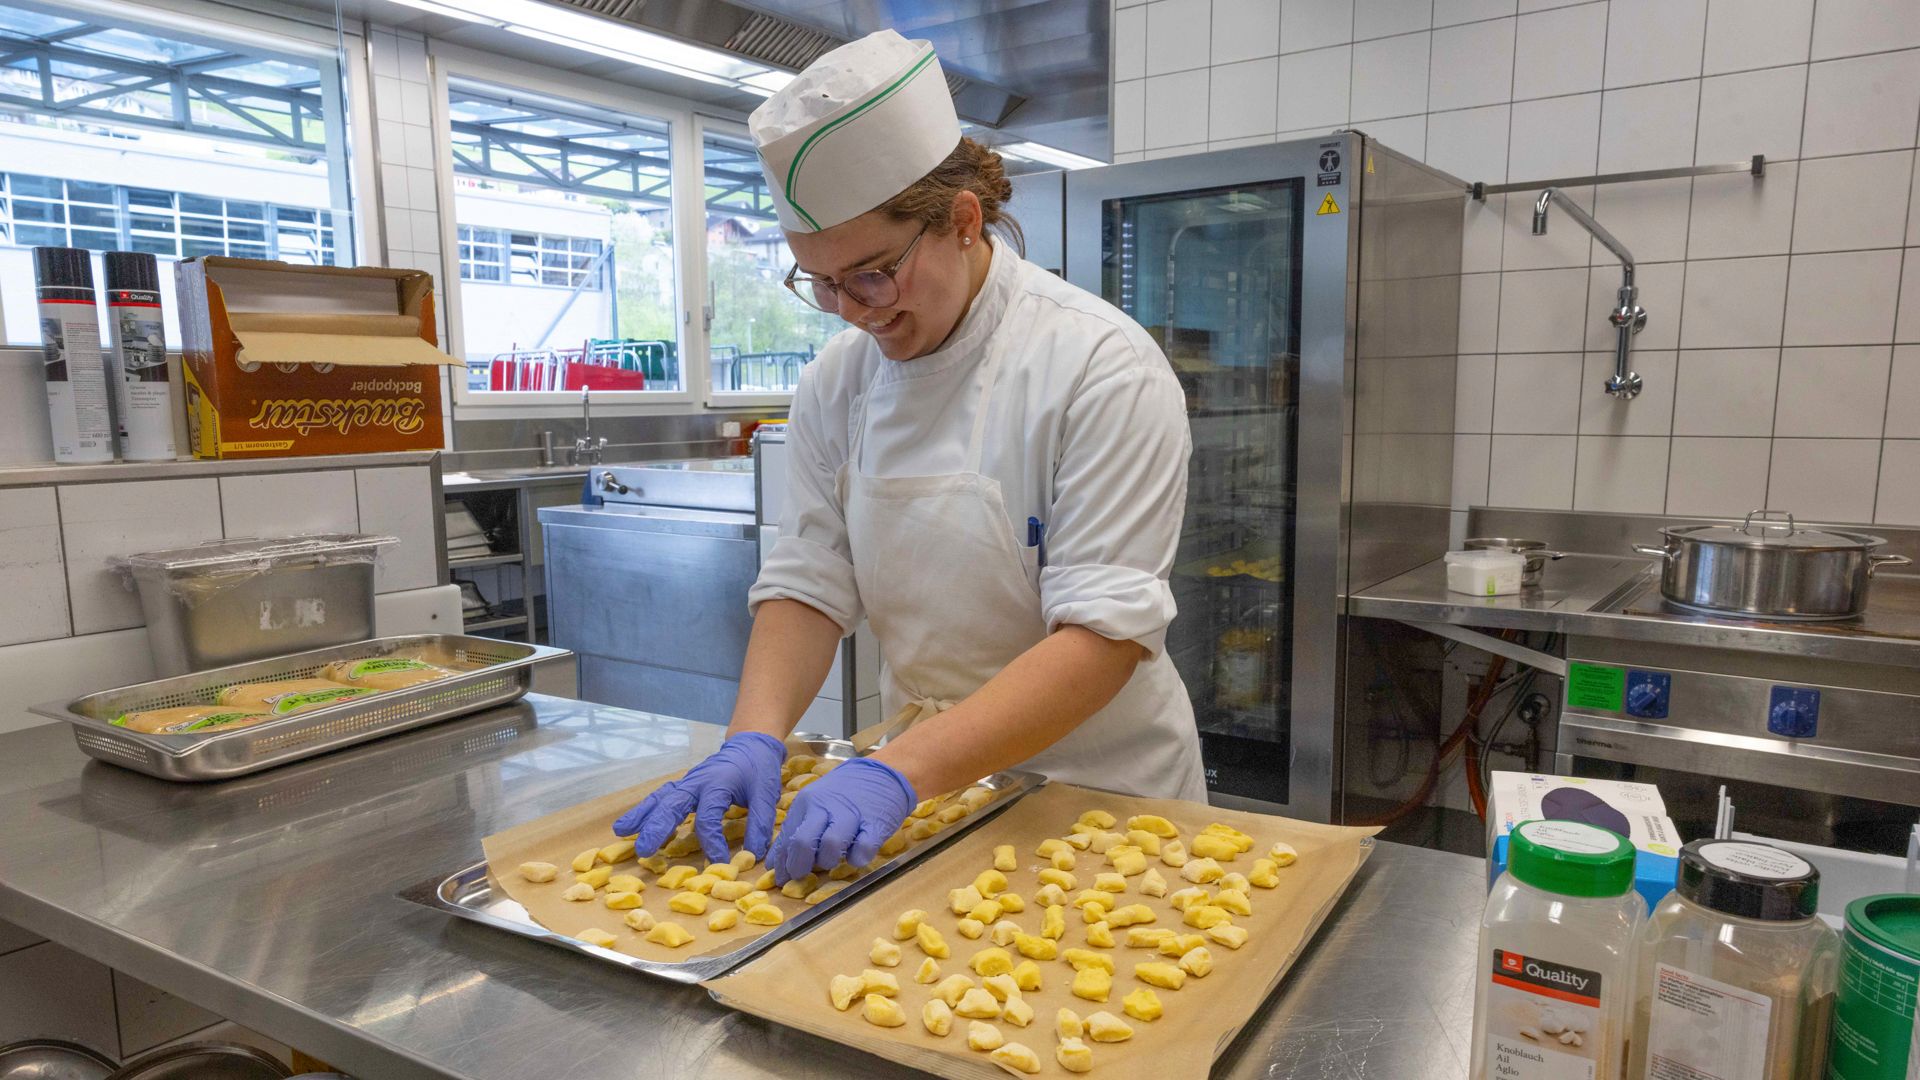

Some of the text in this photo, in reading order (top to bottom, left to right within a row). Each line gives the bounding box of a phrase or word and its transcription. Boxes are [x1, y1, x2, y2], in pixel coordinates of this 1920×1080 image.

[130, 293, 154, 302] Quality
[351, 378, 422, 394] Backpapier
[249, 398, 425, 436] Backstar
[245, 441, 289, 449] Gastronorm
[1525, 963, 1589, 990] Quality
[1496, 1042, 1544, 1062] Knoblauch
[1496, 1054, 1510, 1063] Ail
[1496, 1063, 1520, 1076] Aglio
